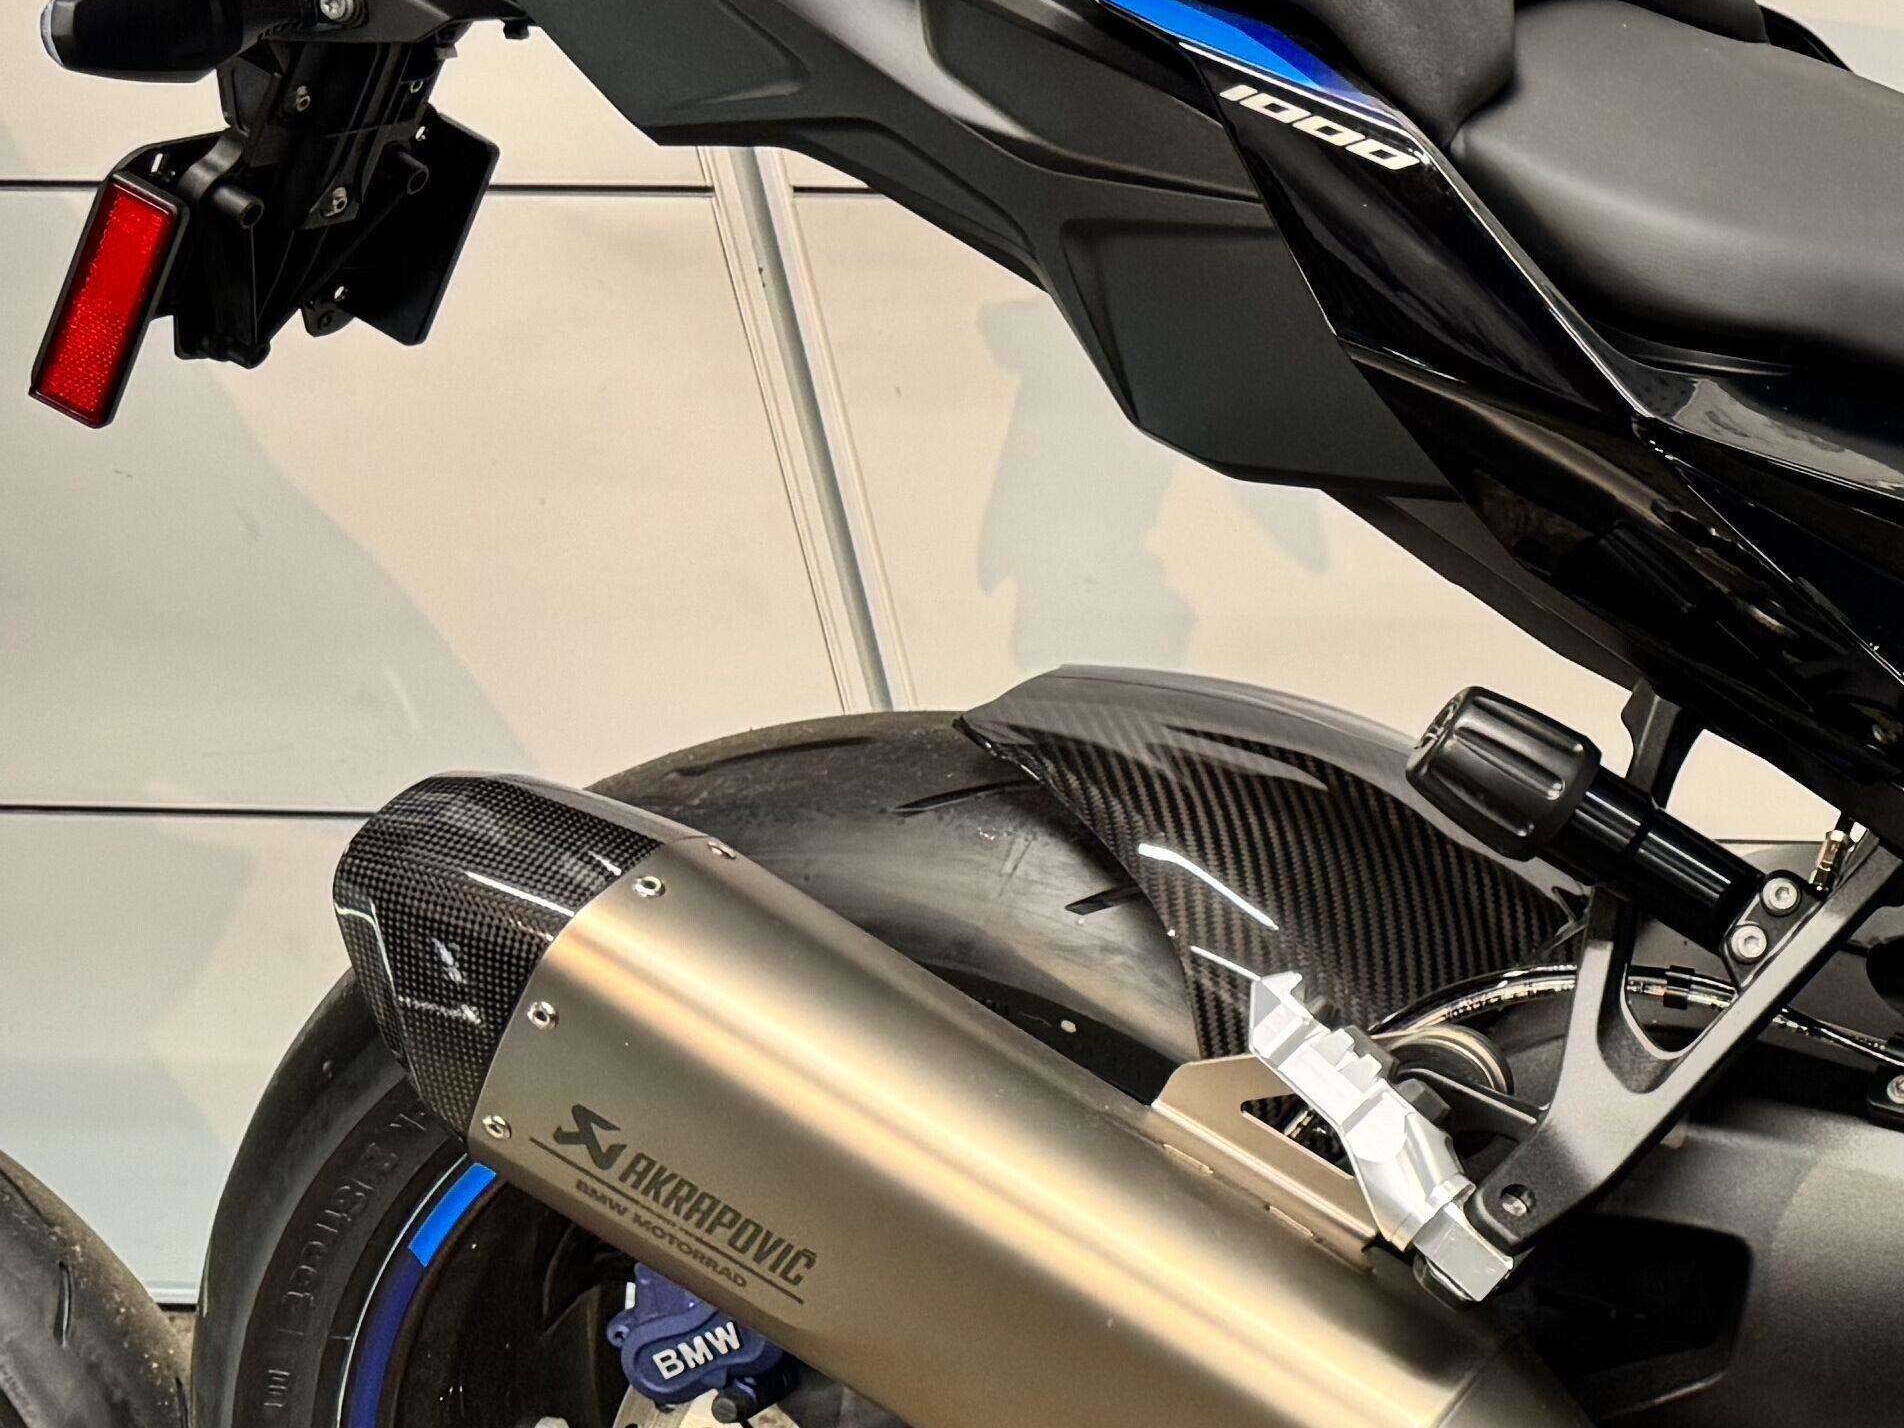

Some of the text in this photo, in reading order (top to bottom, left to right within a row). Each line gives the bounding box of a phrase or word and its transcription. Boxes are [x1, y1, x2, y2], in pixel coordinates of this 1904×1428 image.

[1219, 83, 1421, 171] 1000
[575, 1178, 748, 1289] BMW MOTORRAD
[652, 1321, 740, 1380] BMW
